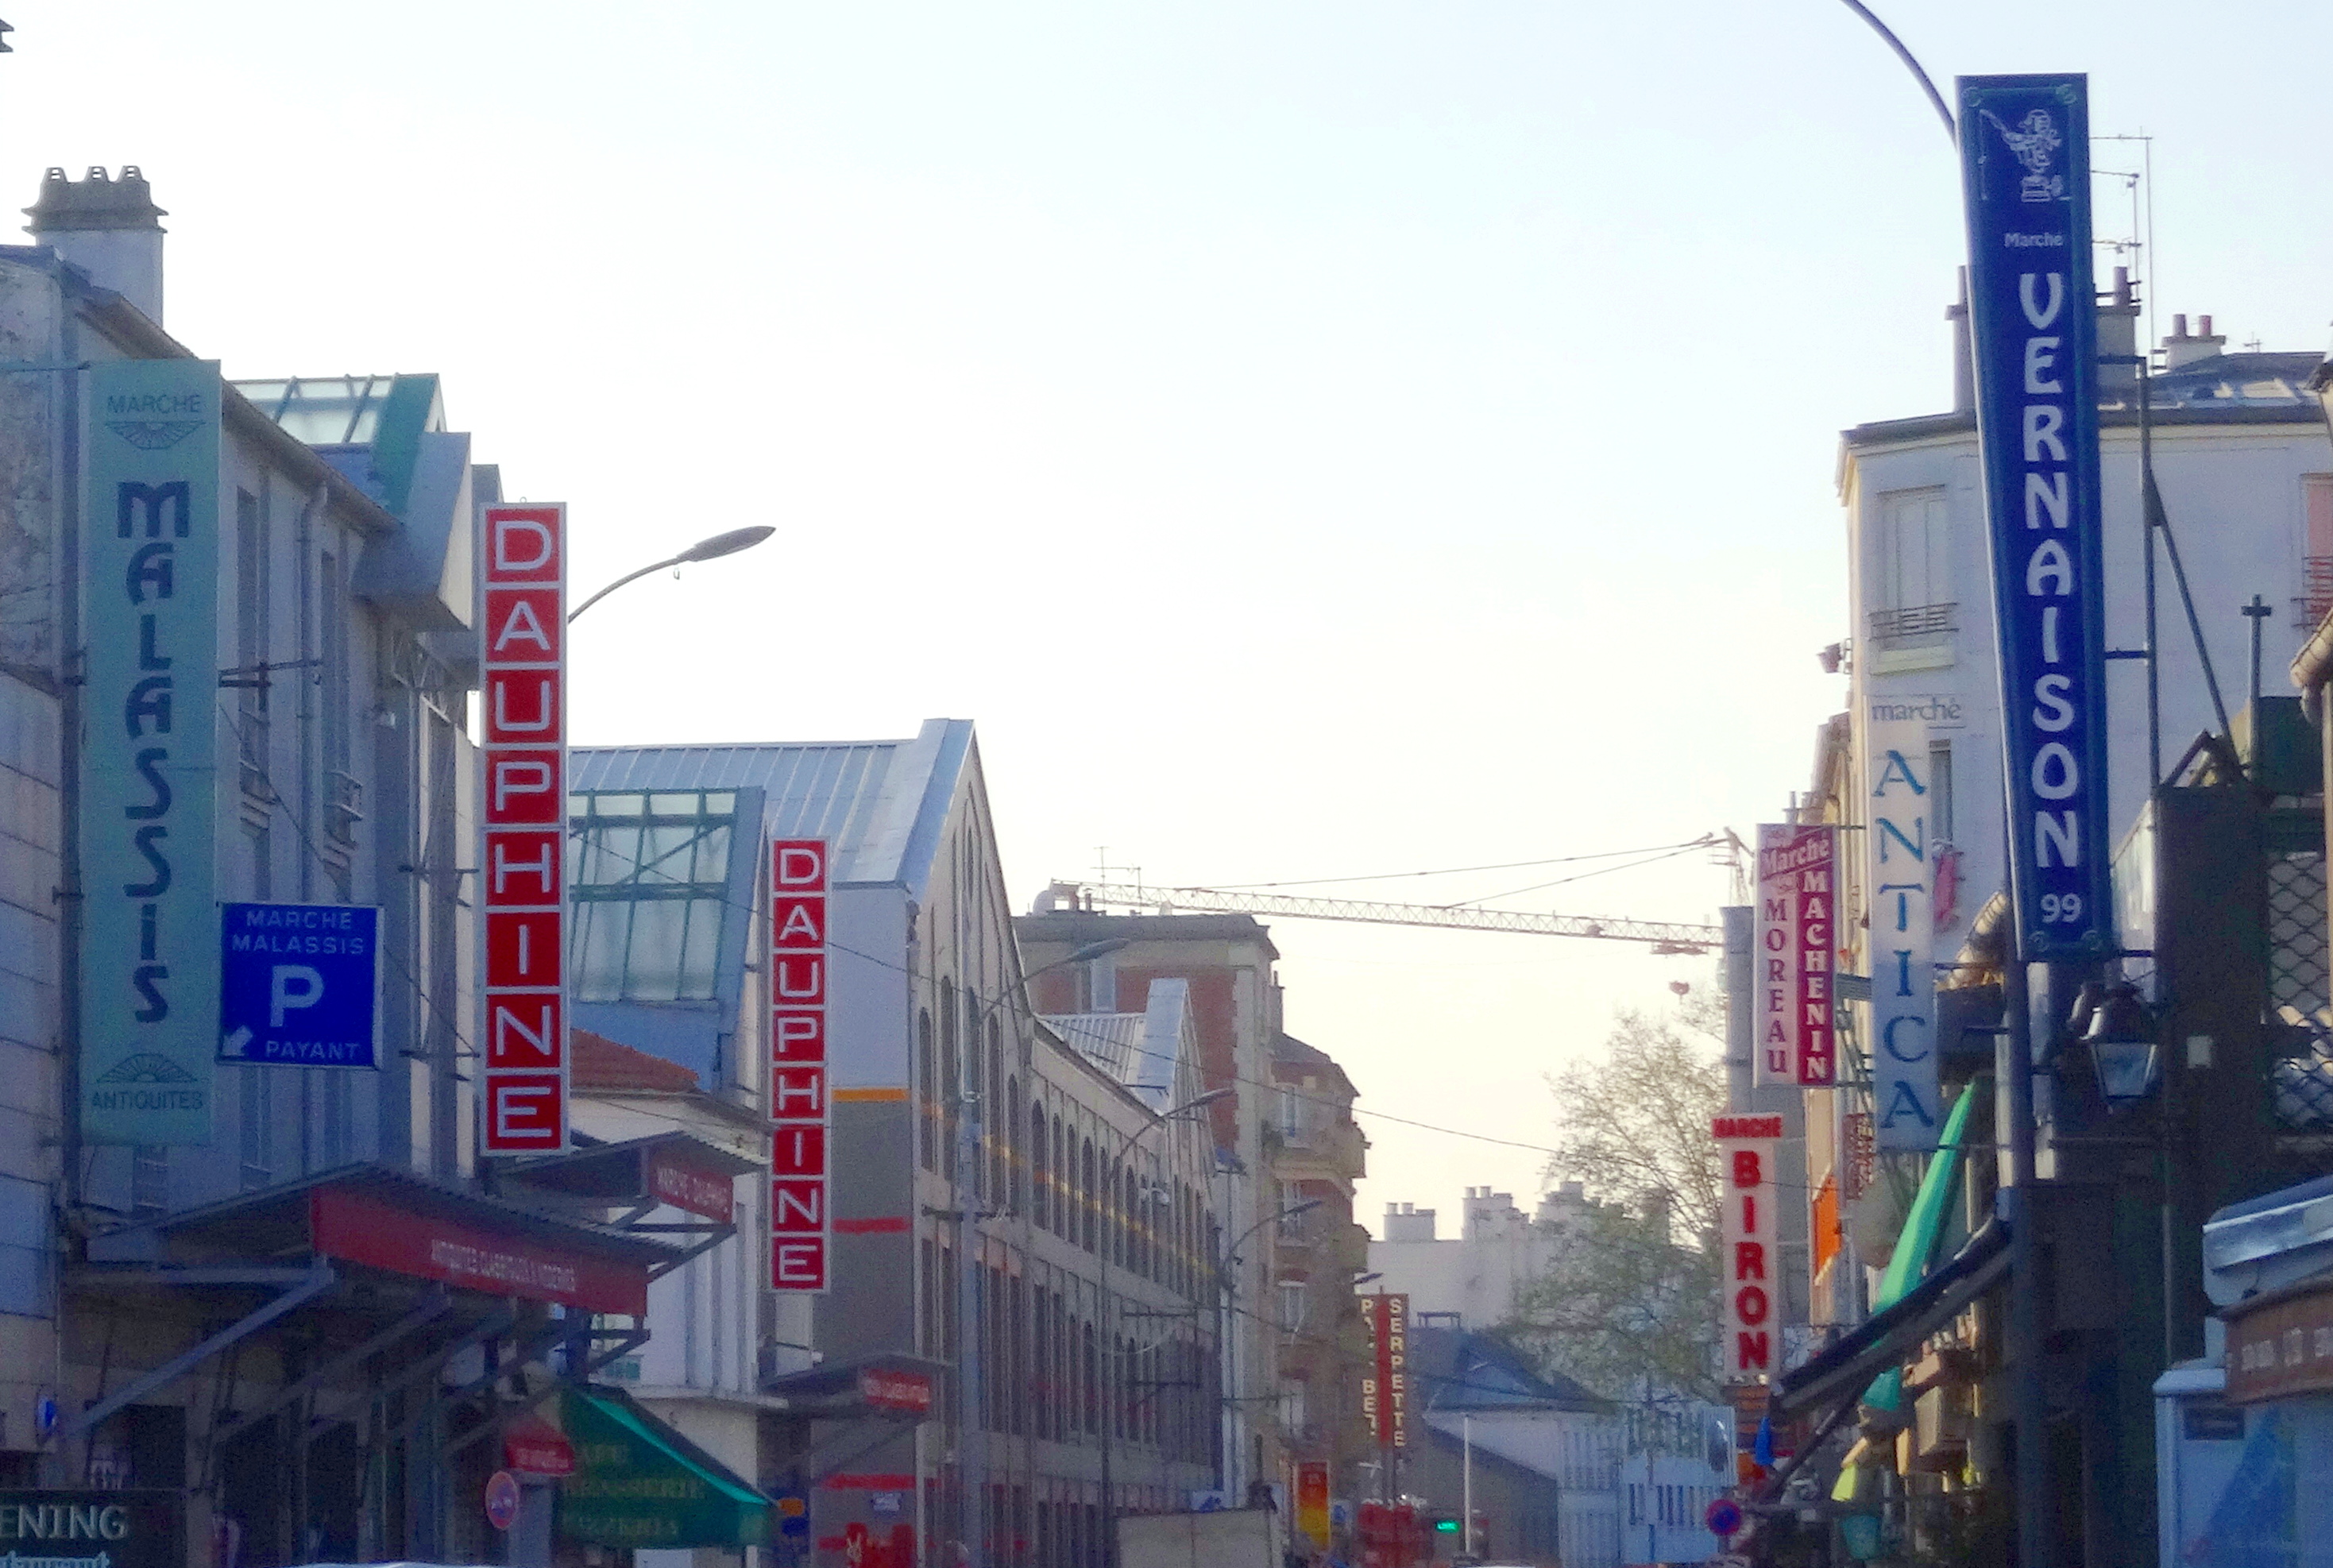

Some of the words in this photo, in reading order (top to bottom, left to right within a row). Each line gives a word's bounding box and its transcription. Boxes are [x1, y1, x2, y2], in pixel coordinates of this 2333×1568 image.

[107, 395, 201, 413] MARCHE
[2019, 272, 2079, 867] VERNAISON
[493, 520, 553, 1139] DAUPHINE
[2040, 893, 2083, 924] 99
[231, 933, 365, 955] MALASSIS
[245, 910, 353, 929] MARCHE
[268, 964, 325, 1027] P
[1764, 898, 1787, 1073] MOREAU
[1802, 871, 1828, 1079] MACHENIN
[1873, 749, 1934, 1128] ANTICA
[264, 1040, 360, 1060] PAYANT
[777, 848, 821, 1281] DAUPHINE
[1732, 1150, 1770, 1372] BIRON
[1389, 1298, 1407, 1446] SERPETTE
